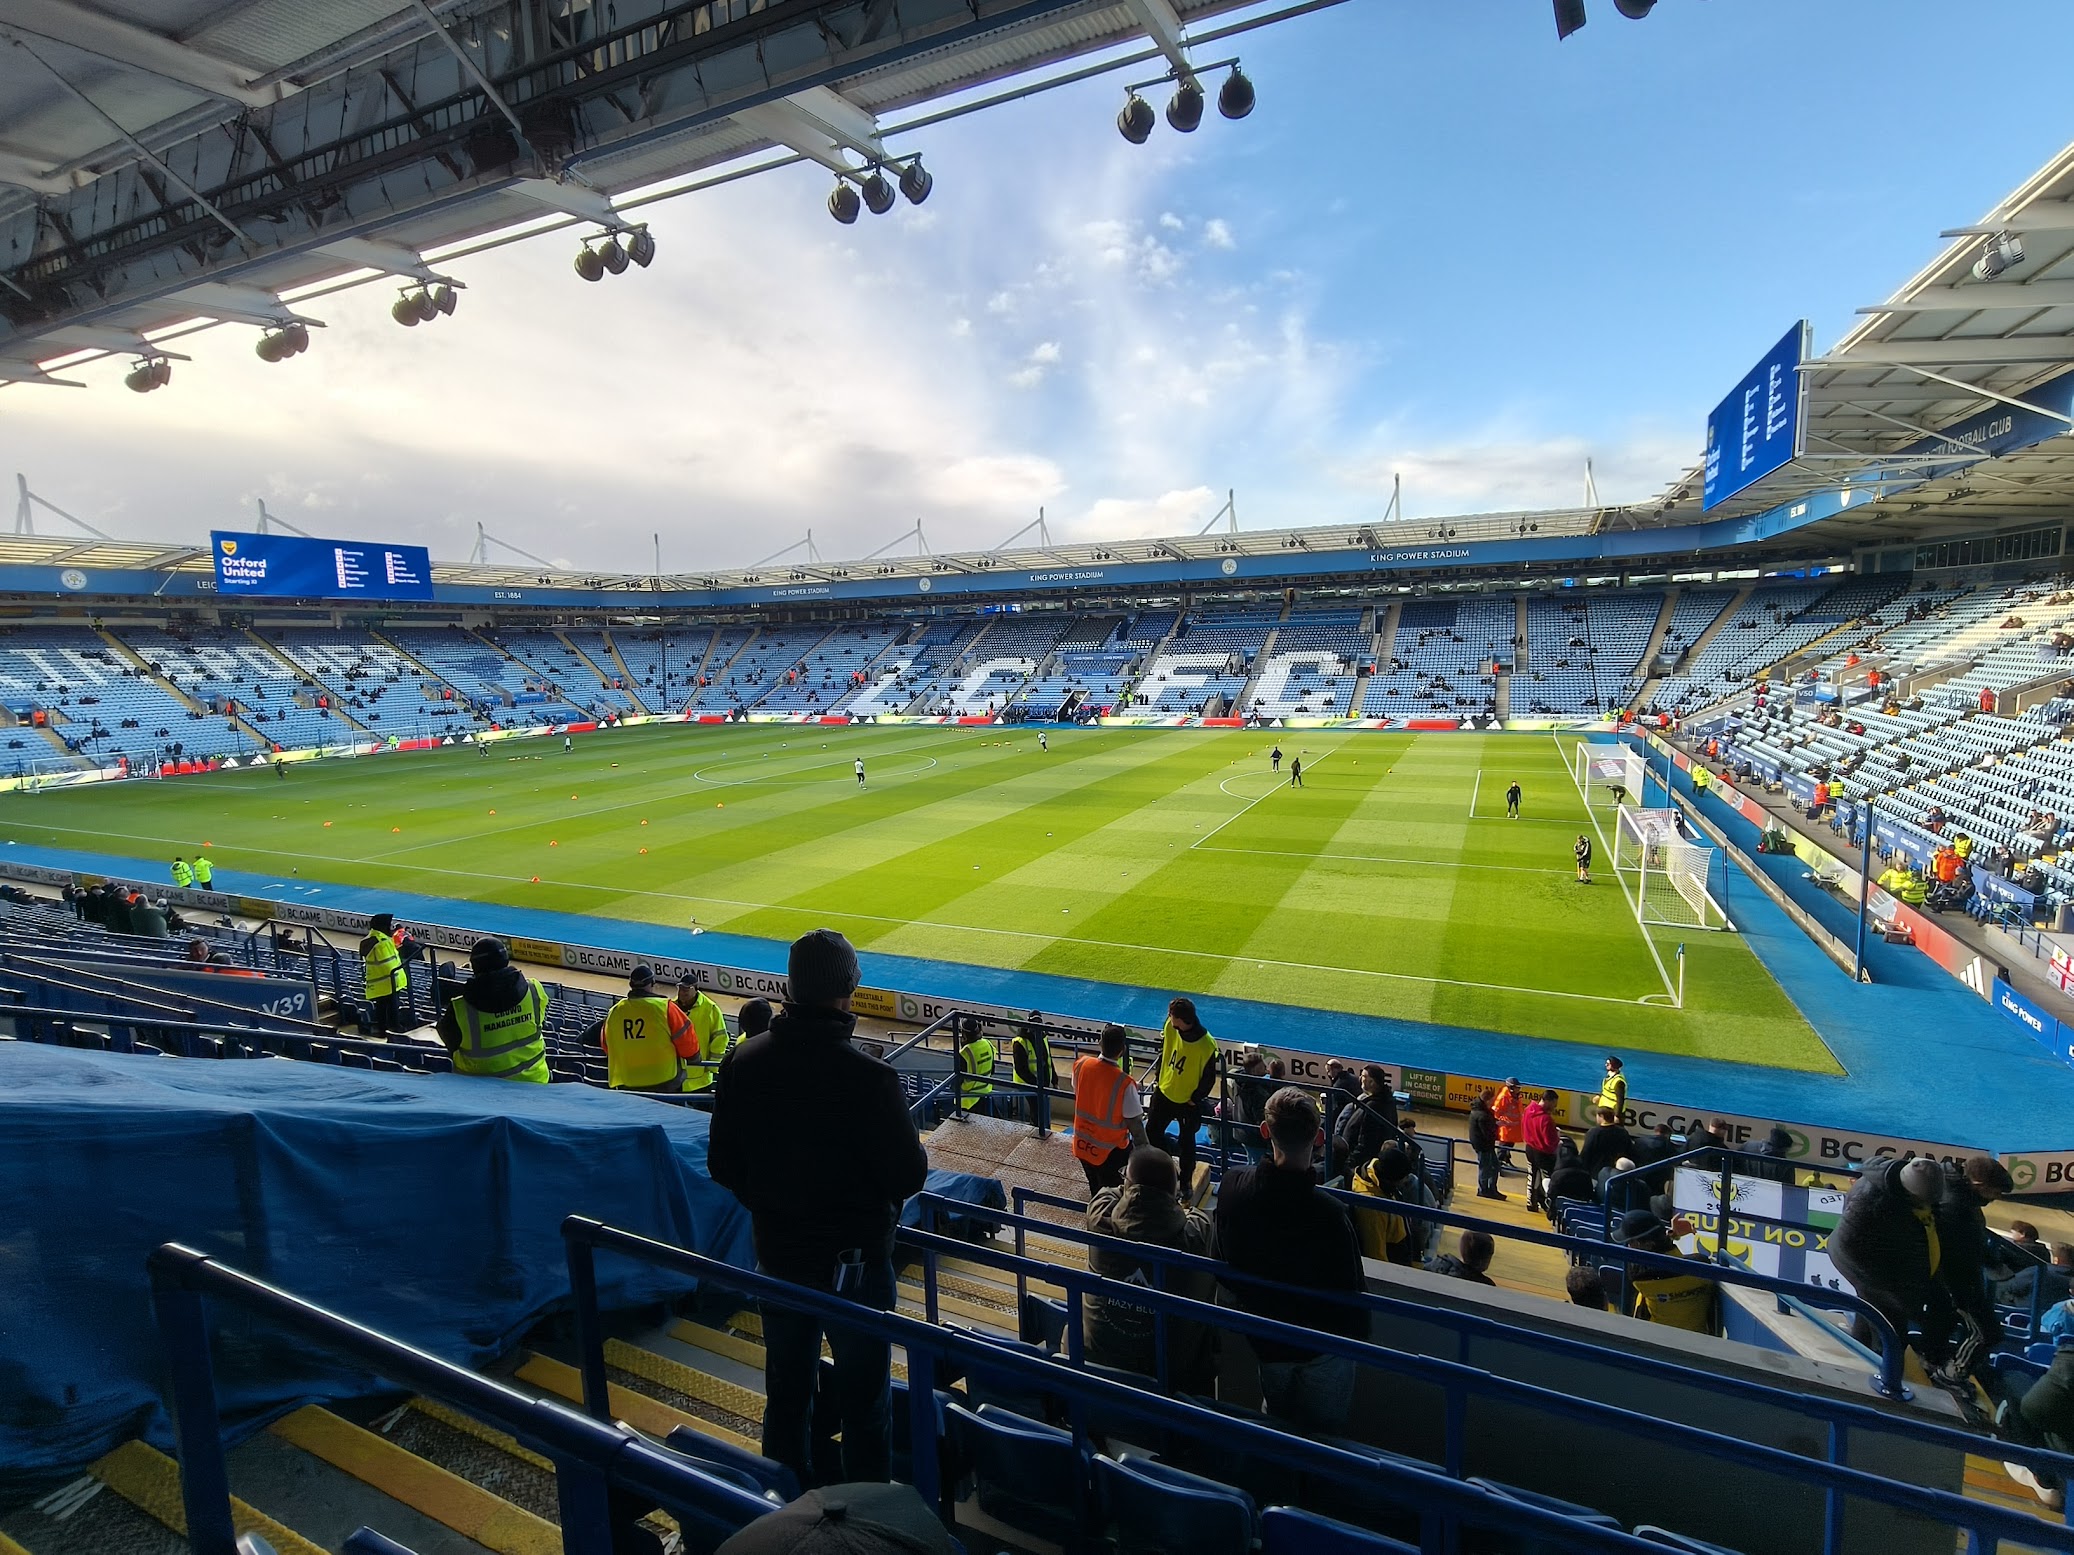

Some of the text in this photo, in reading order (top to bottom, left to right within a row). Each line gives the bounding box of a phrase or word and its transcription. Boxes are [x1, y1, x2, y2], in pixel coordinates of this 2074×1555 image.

[1947, 425, 1987, 455] FOOTBALL
[1988, 416, 2011, 438] CLUB
[222, 557, 267, 568] Oxford
[1370, 549, 1470, 563] KING POWER STADIUM
[222, 566, 266, 578] United
[1029, 571, 1104, 582] KING POWER STADIUM
[224, 578, 250, 586] Starting
[494, 591, 507, 599] EST.
[807, 587, 830, 595] STADIUM
[287, 907, 322, 923] BC.GAME
[579, 952, 631, 971] BC.GAME
[736, 975, 788, 995] BC.GAM
[854, 991, 883, 1002] ARRESTABLE
[262, 993, 305, 1016] V39
[855, 1001, 868, 1009] PASS
[879, 1004, 894, 1013] POINT
[2002, 994, 2042, 1032] KING POWER
[484, 1013, 533, 1033] MANAGEMENT
[623, 1018, 646, 1040] R2
[1168, 1050, 1187, 1076] A4
[1409, 1073, 1423, 1081] LIFT
[1405, 1080, 1442, 1092] IN CASE OF
[1465, 1083, 1473, 1092] IT
[1474, 1084, 1482, 1093] IS
[1077, 1140, 1099, 1157] CFC
[1107, 1297, 1133, 1310] HAZY
